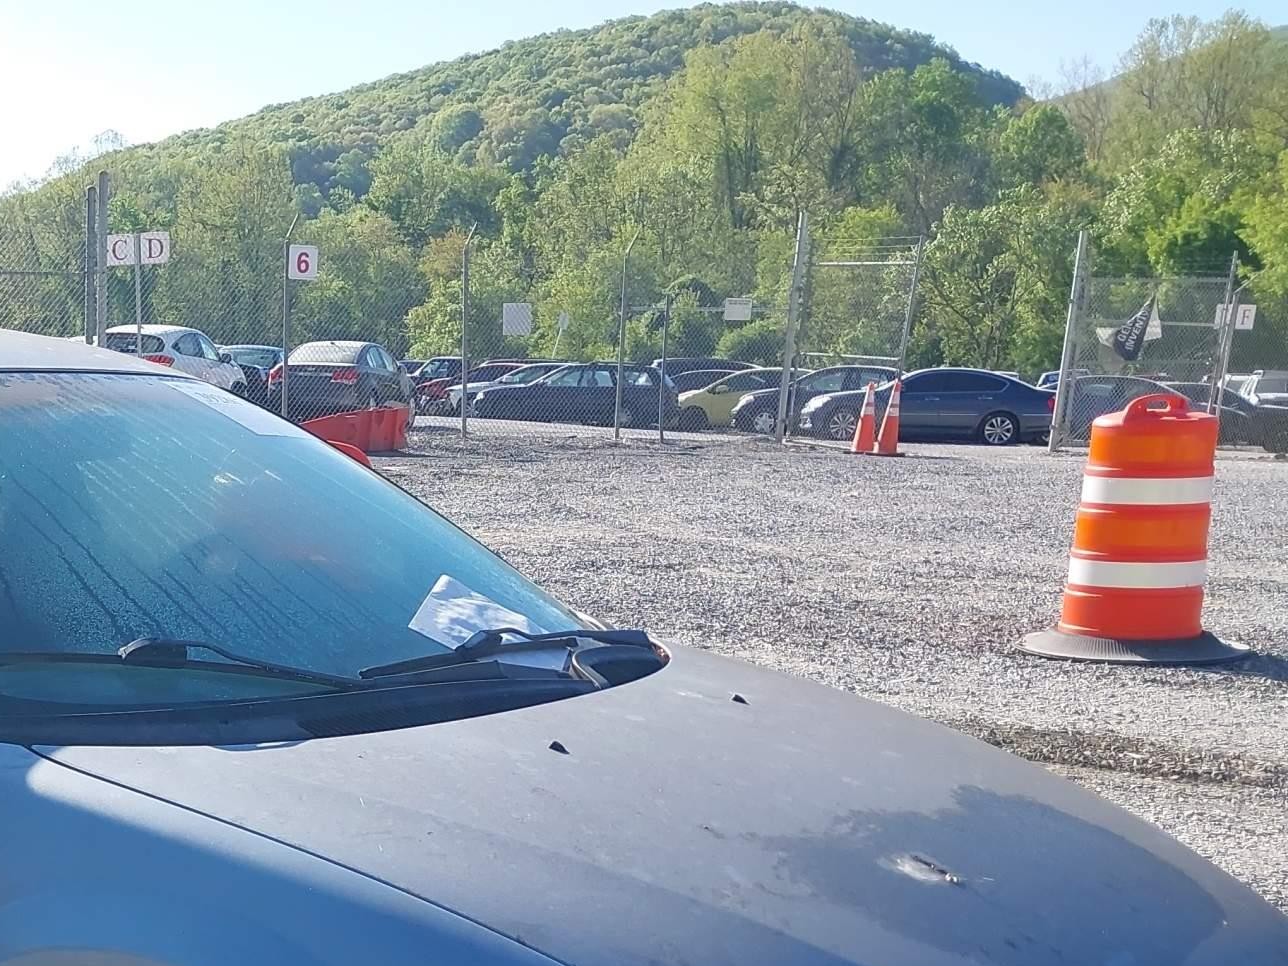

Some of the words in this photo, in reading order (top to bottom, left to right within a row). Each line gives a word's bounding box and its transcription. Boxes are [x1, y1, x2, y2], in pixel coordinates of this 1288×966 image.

[112, 239, 128, 261] C
[146, 238, 164, 259] D
[297, 251, 310, 274] 6
[1240, 308, 1251, 325] F
